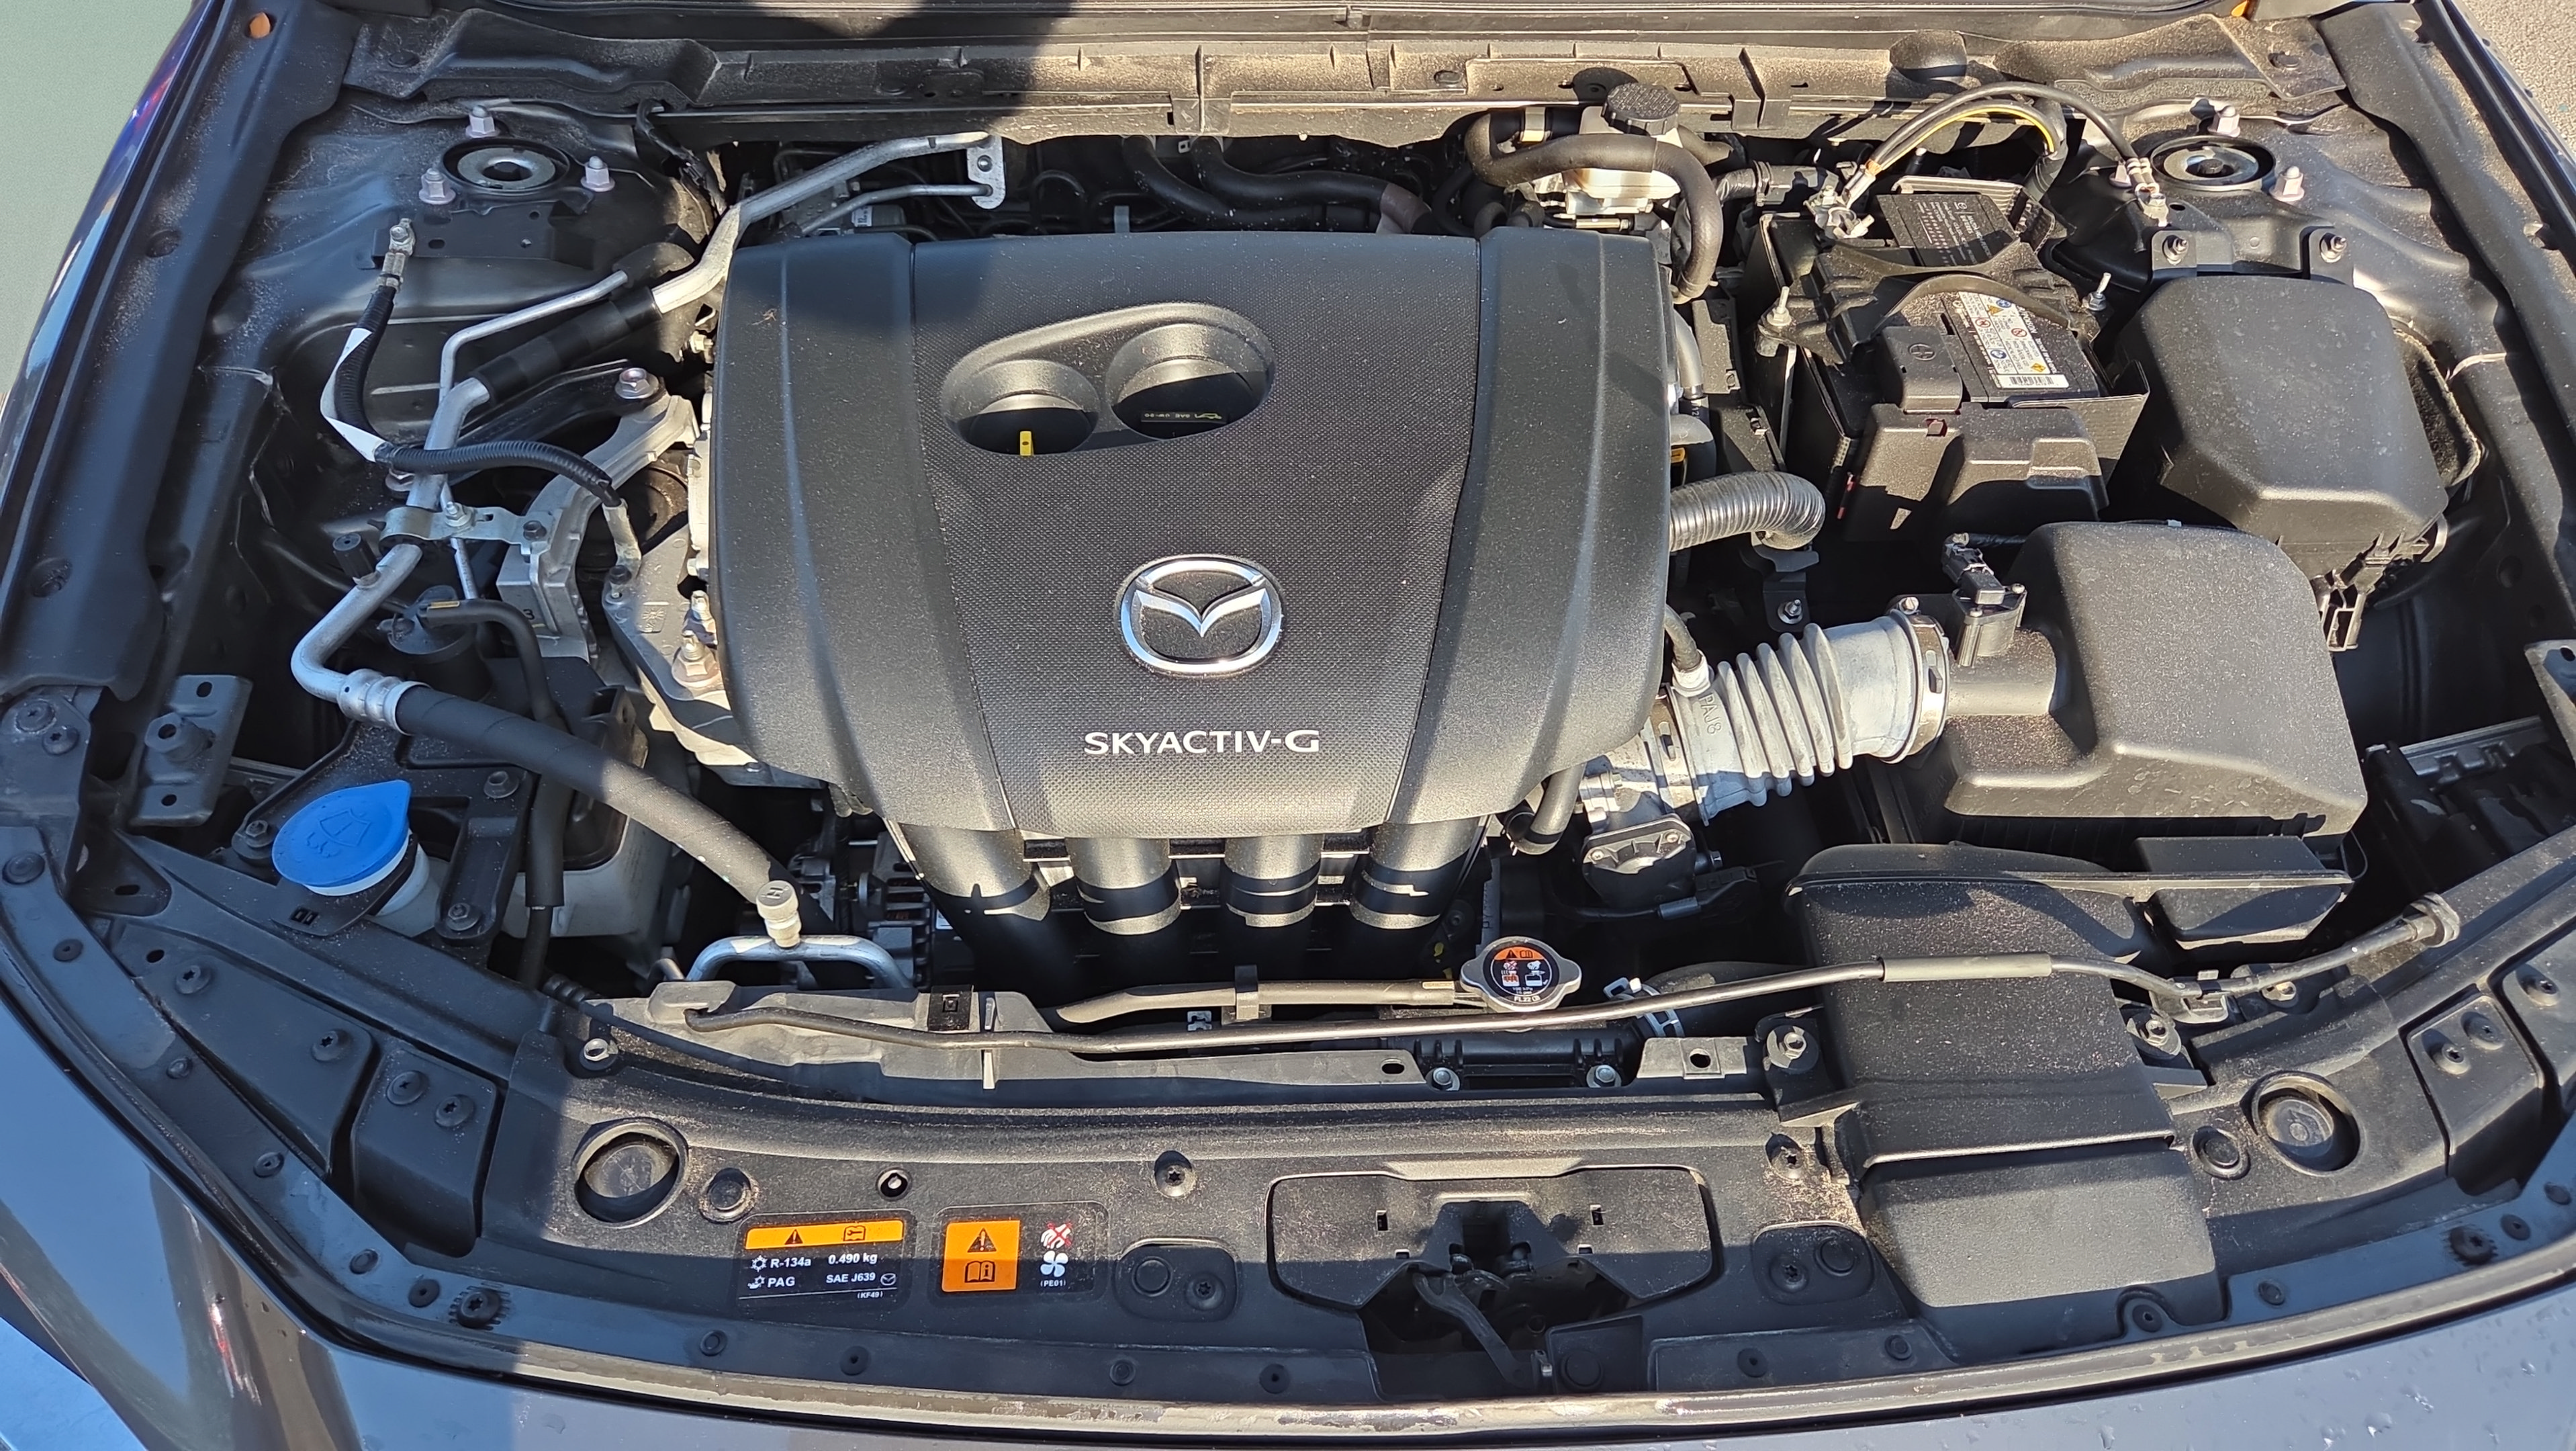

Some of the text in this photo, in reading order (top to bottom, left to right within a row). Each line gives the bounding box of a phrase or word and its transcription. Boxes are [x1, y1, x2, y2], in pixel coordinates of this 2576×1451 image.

[1698, 693, 1722, 735] PAJ8
[1083, 730, 1320, 755] SKYACTIV-G
[770, 1252, 878, 1268] R-134a 0.490 kg
[767, 1272, 876, 1288] PAG SAE J639
[1040, 1279, 1066, 1287] (PE01)
[857, 1291, 883, 1299] (KF49)
